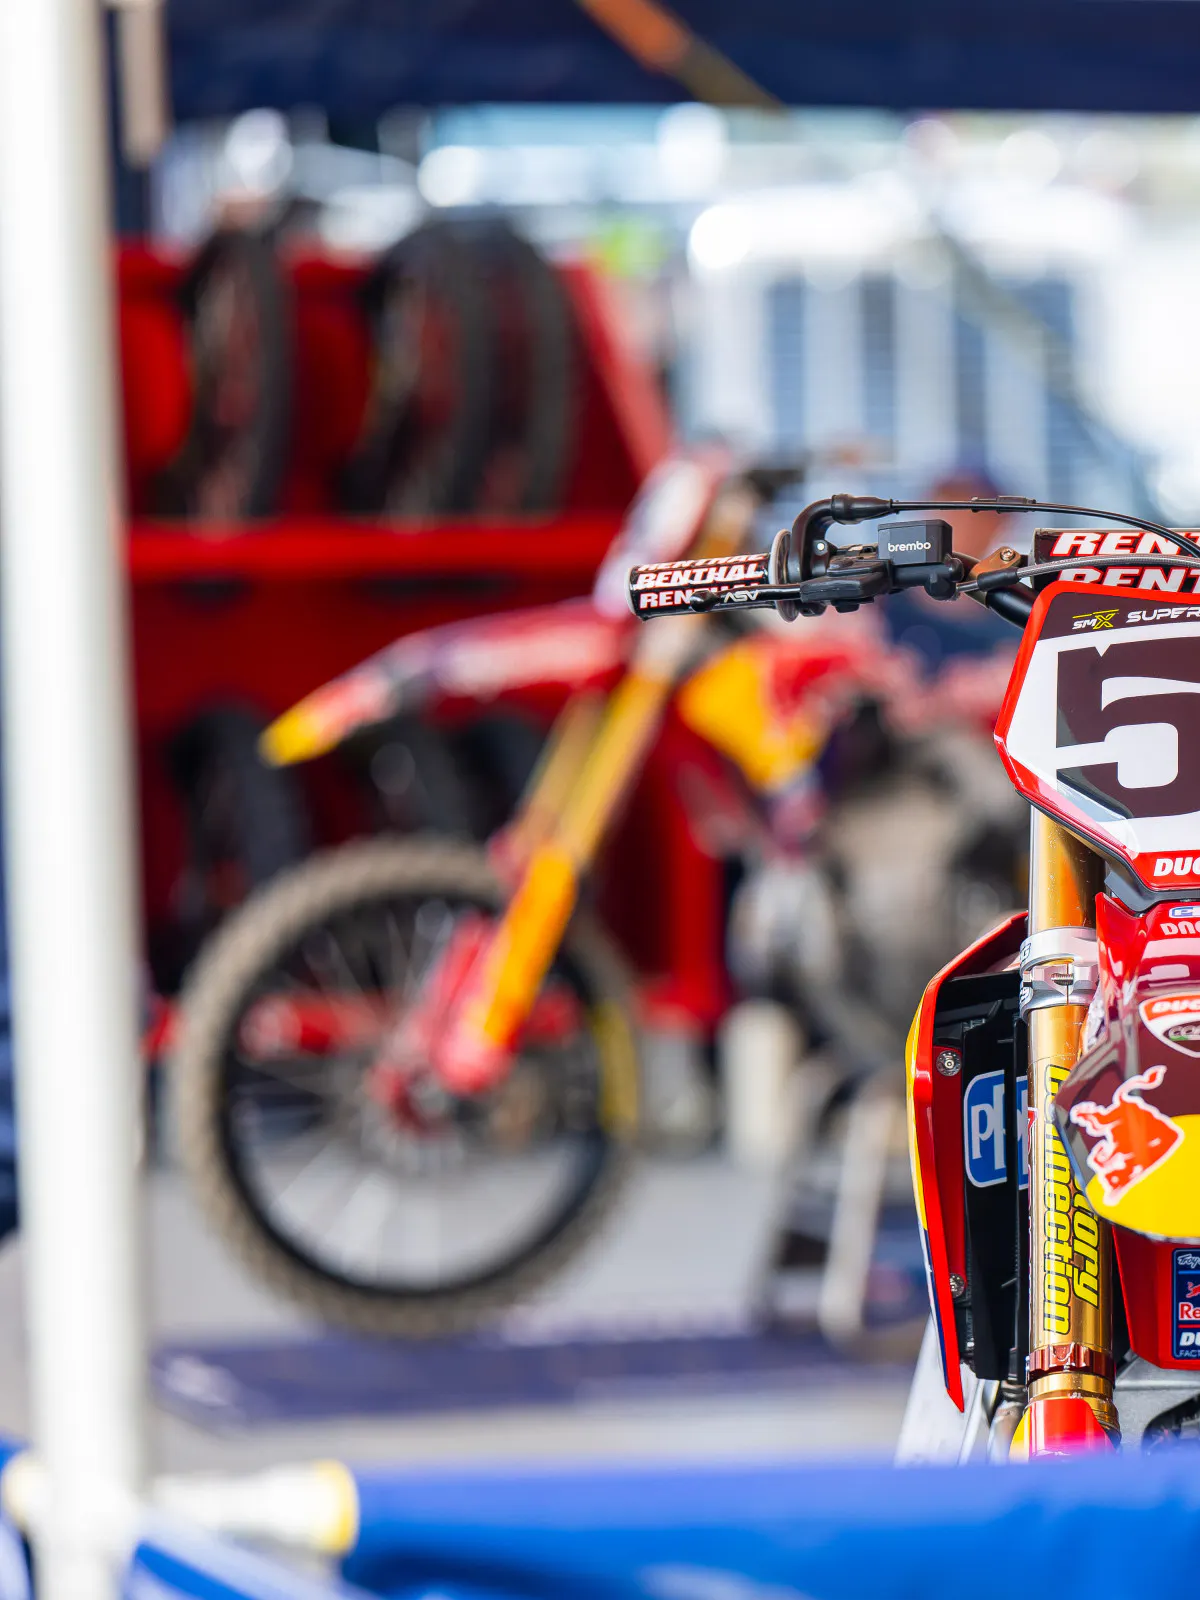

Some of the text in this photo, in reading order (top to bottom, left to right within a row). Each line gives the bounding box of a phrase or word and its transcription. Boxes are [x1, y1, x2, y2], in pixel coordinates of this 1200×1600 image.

[887, 540, 932, 552] brembo
[634, 562, 765, 590] RENTHAL
[1072, 612, 1116, 630] SMX
